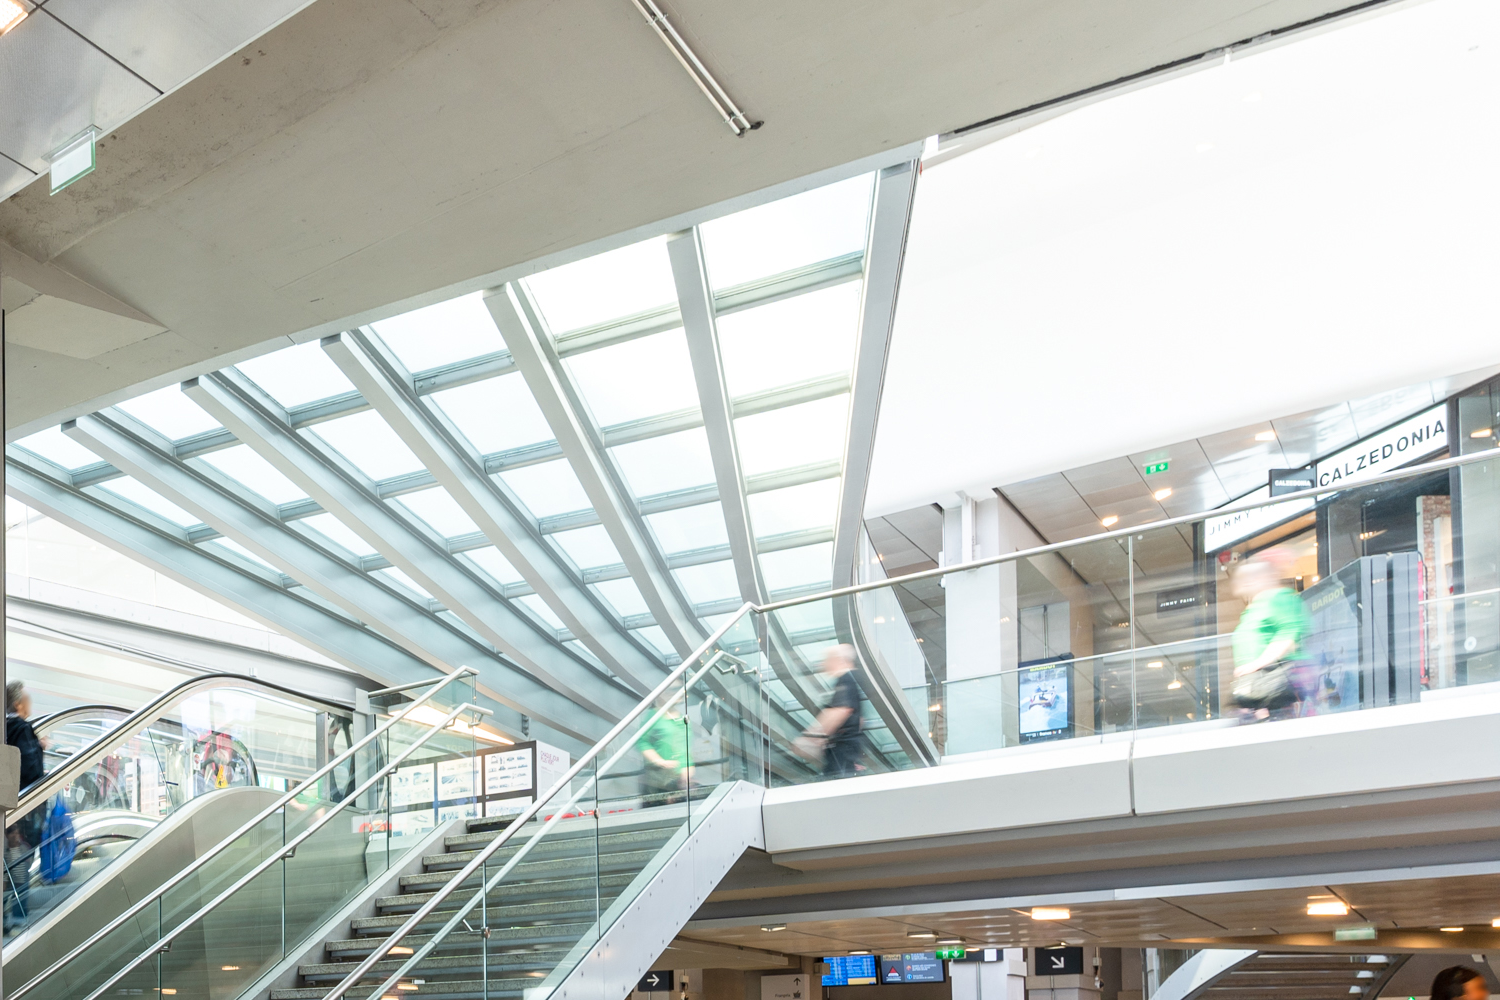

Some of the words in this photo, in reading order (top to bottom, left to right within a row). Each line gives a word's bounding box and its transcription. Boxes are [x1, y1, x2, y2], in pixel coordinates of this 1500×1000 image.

[1319, 420, 1445, 487] CALZEDONIA
[1274, 479, 1312, 487] CALZEDONIA
[1209, 510, 1251, 535] JIMMY
[1311, 586, 1345, 612] BARDOT
